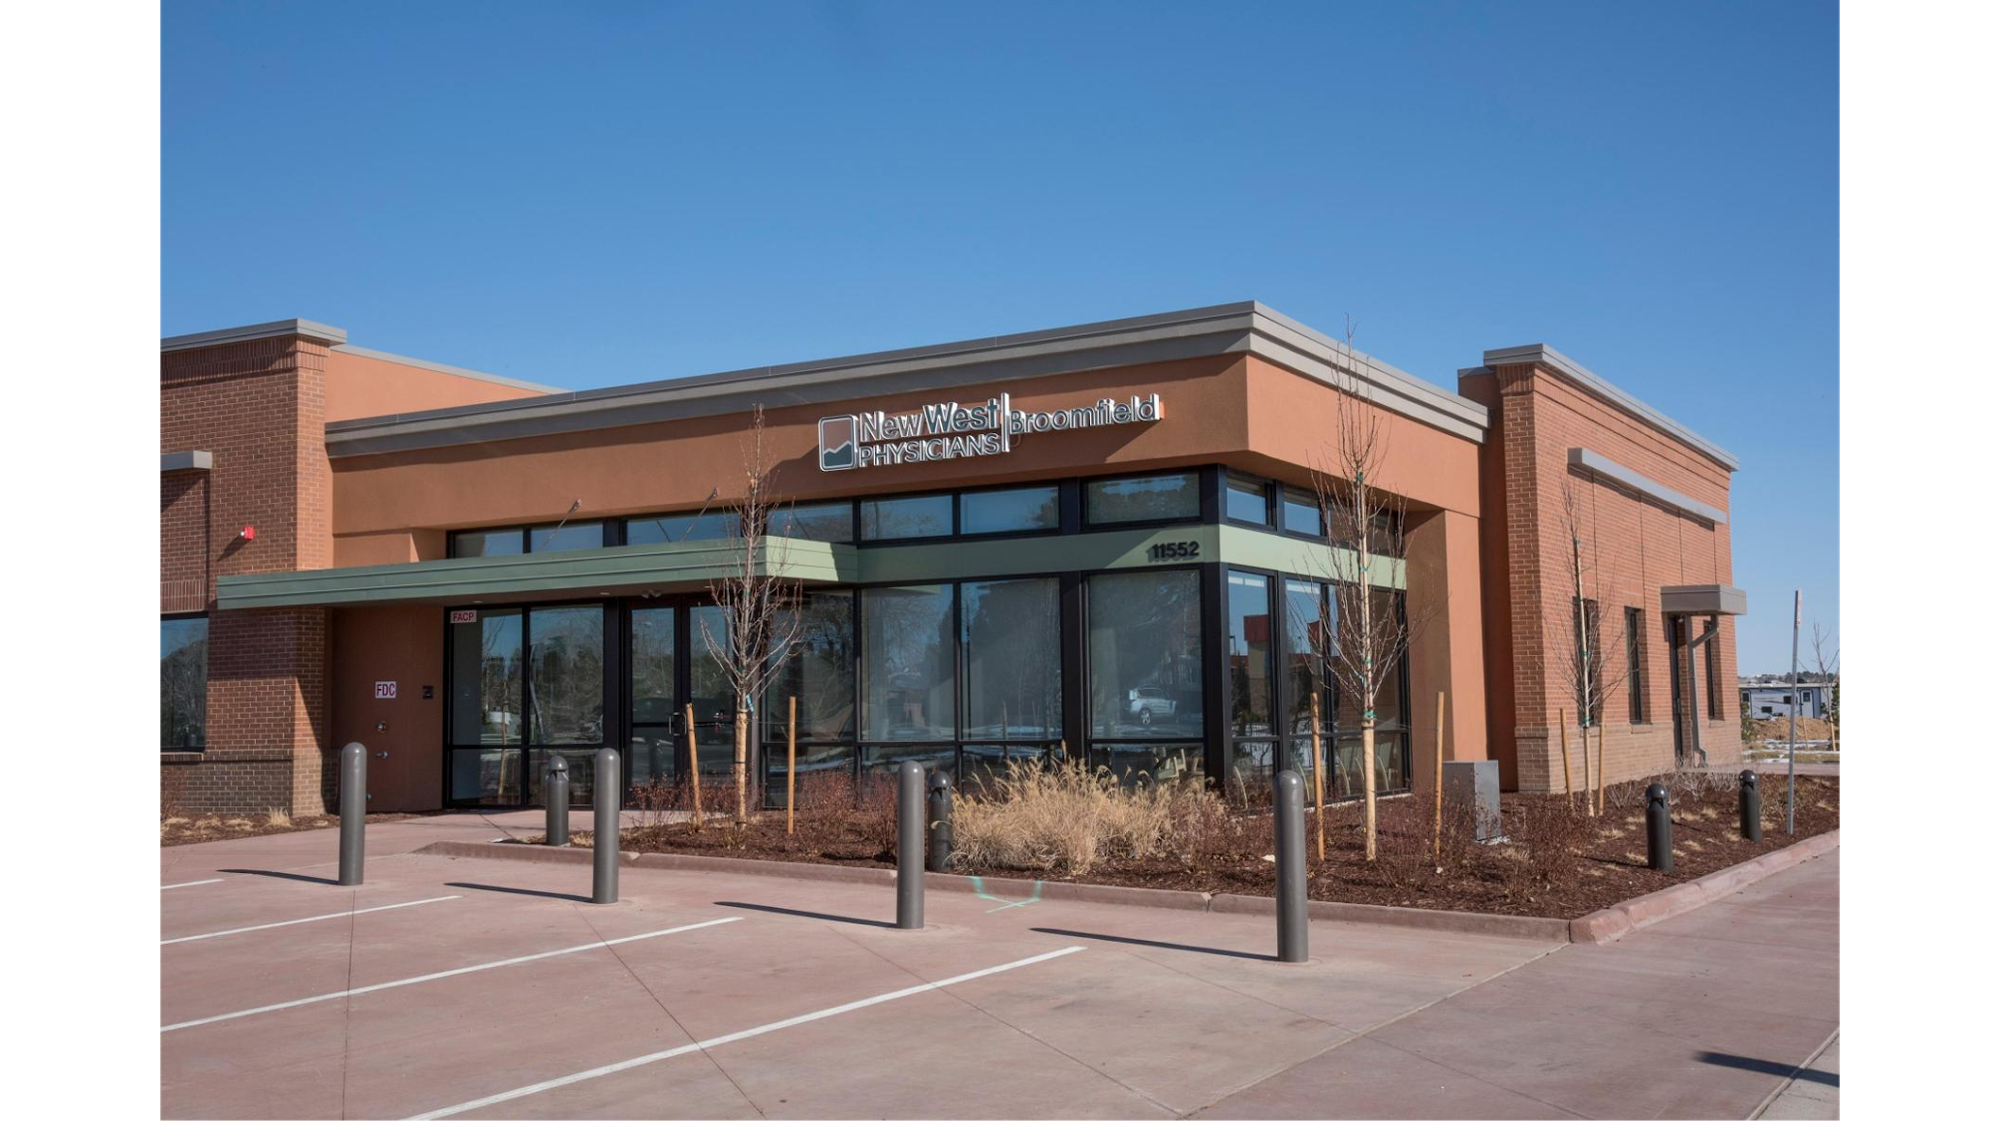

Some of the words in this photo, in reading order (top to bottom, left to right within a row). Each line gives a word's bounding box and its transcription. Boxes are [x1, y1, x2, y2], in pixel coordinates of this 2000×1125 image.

[1009, 393, 1160, 434] Broomfield
[859, 432, 1001, 467] PHYSICIANS
[1152, 541, 1200, 559] 11552
[453, 611, 475, 622] FACP
[376, 683, 396, 697] FDC
